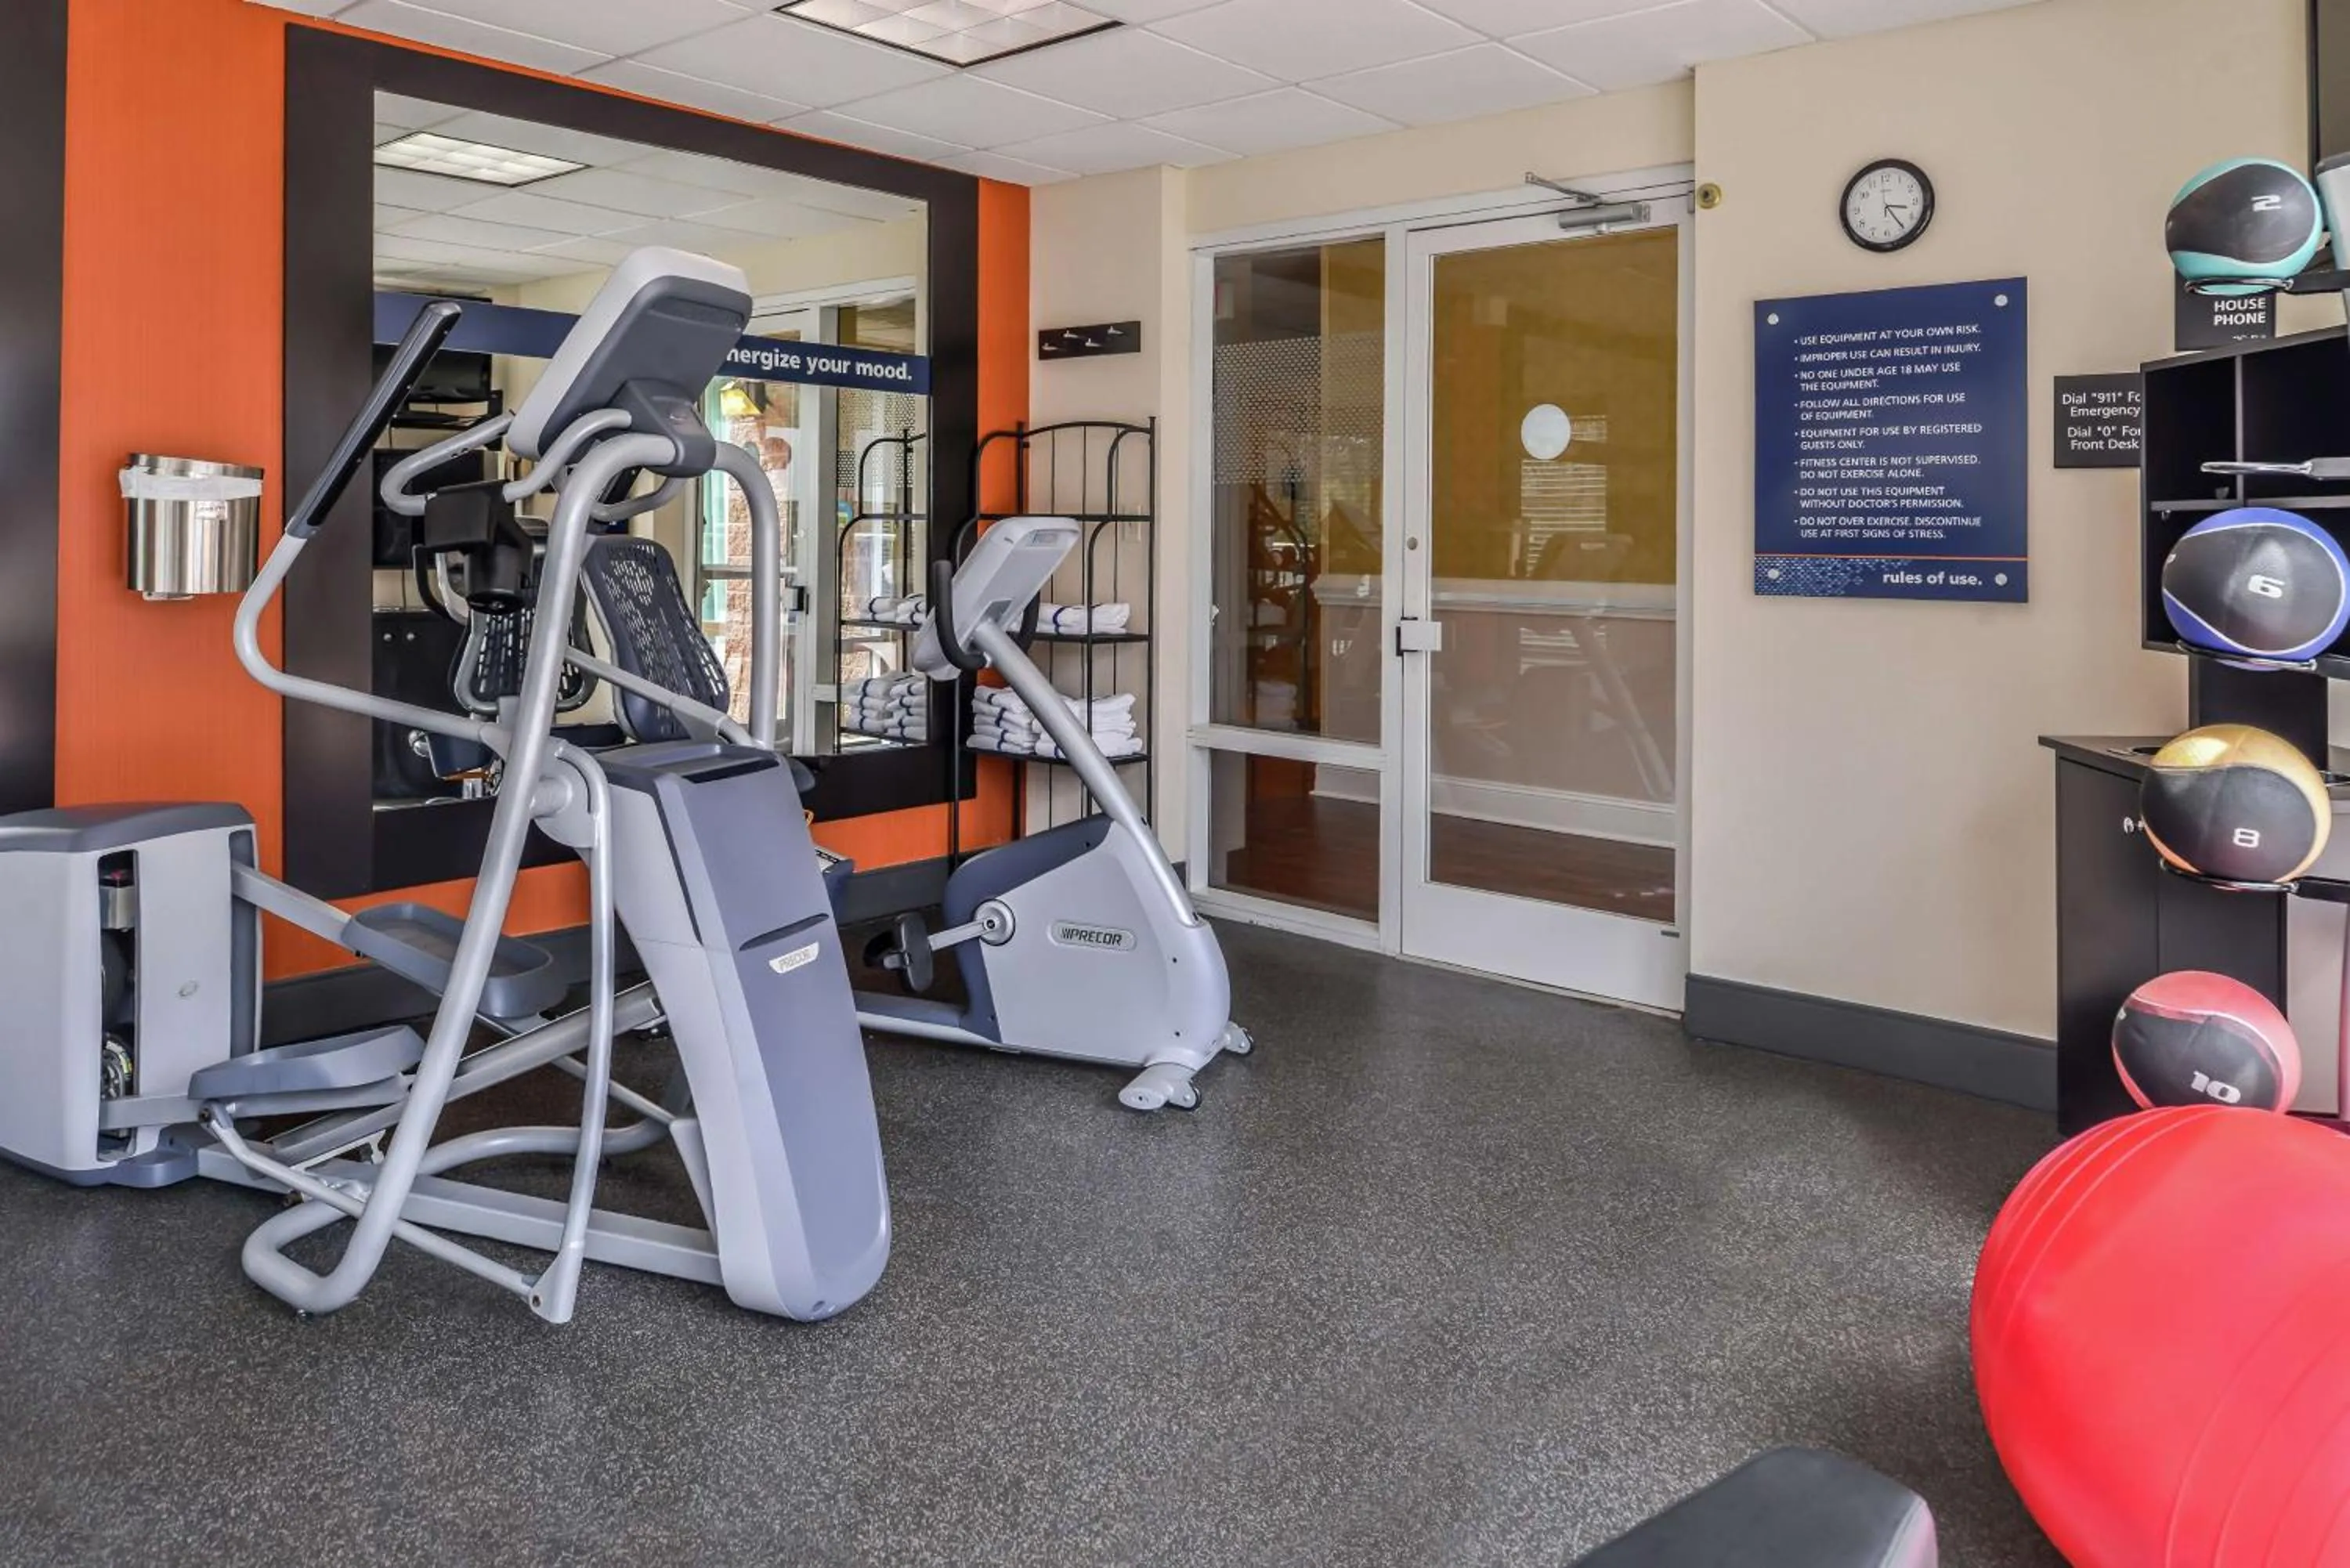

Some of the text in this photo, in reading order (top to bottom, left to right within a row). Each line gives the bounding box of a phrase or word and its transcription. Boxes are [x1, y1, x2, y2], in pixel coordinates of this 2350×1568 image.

[2251, 194, 2281, 211] 2
[2214, 298, 2266, 313] HOUSE
[2214, 312, 2265, 326] PHONE
[1801, 324, 1980, 345] USE EQUIPMENT AT YOUR OWN RISK.
[1800, 352, 1848, 362] IMPROPER
[1894, 346, 1928, 356] RESULT
[1931, 345, 1941, 354] IN
[1944, 343, 1980, 352] INJURY.
[727, 349, 912, 380] nergize your mood.
[1817, 370, 1837, 378] ONE
[1841, 367, 1874, 377] UNDER
[1877, 367, 1896, 375] AGE
[1901, 365, 1912, 374] 18
[1914, 363, 1938, 374] MAY
[1942, 362, 1961, 372] USE
[1800, 379, 1878, 391] THE EQUIPMENT.
[1800, 393, 1965, 408] FOLLOW ALL DIRECTIONS FOR USE
[2063, 392, 2140, 404] Dial "911" Fo
[1801, 410, 1873, 421] OF EQUIPMENT.
[2071, 406, 2140, 418] Emergency
[1801, 424, 1982, 438] EQUIPMENT FOR USE BY REGISTERED
[2068, 426, 2092, 437] Dial
[2098, 426, 2117, 436] "0"
[1801, 440, 1865, 450] GUESTS ONLY.
[2071, 439, 2139, 450] Front Desk
[1800, 458, 1836, 467] FITNESS
[1839, 457, 1876, 466] CENTER
[1891, 457, 1911, 465] NOT
[1916, 455, 1980, 464] SUPERVISED.
[1818, 470, 1838, 479] NOT
[1841, 469, 1884, 478] EXERCISE
[1888, 468, 1924, 478] ALONE.
[1841, 487, 1858, 496] USE
[1861, 487, 1882, 496] THIS
[1885, 486, 1945, 496] EQUIPMENT
[1800, 499, 1846, 508] WITHOUT
[1900, 499, 1963, 508] PERMISSION.
[1800, 517, 1815, 526] DO
[1817, 517, 1837, 526] NOT
[1839, 517, 1864, 526] OVER
[1914, 517, 1981, 526] DISCONTINUE
[1801, 529, 1945, 539] USE AT FIRST SIGNS OF STRESS.
[1883, 572, 1982, 586] rules of use.
[2247, 574, 2286, 598] 6
[2232, 828, 2260, 848] 8
[2191, 1071, 2241, 1104] 10
